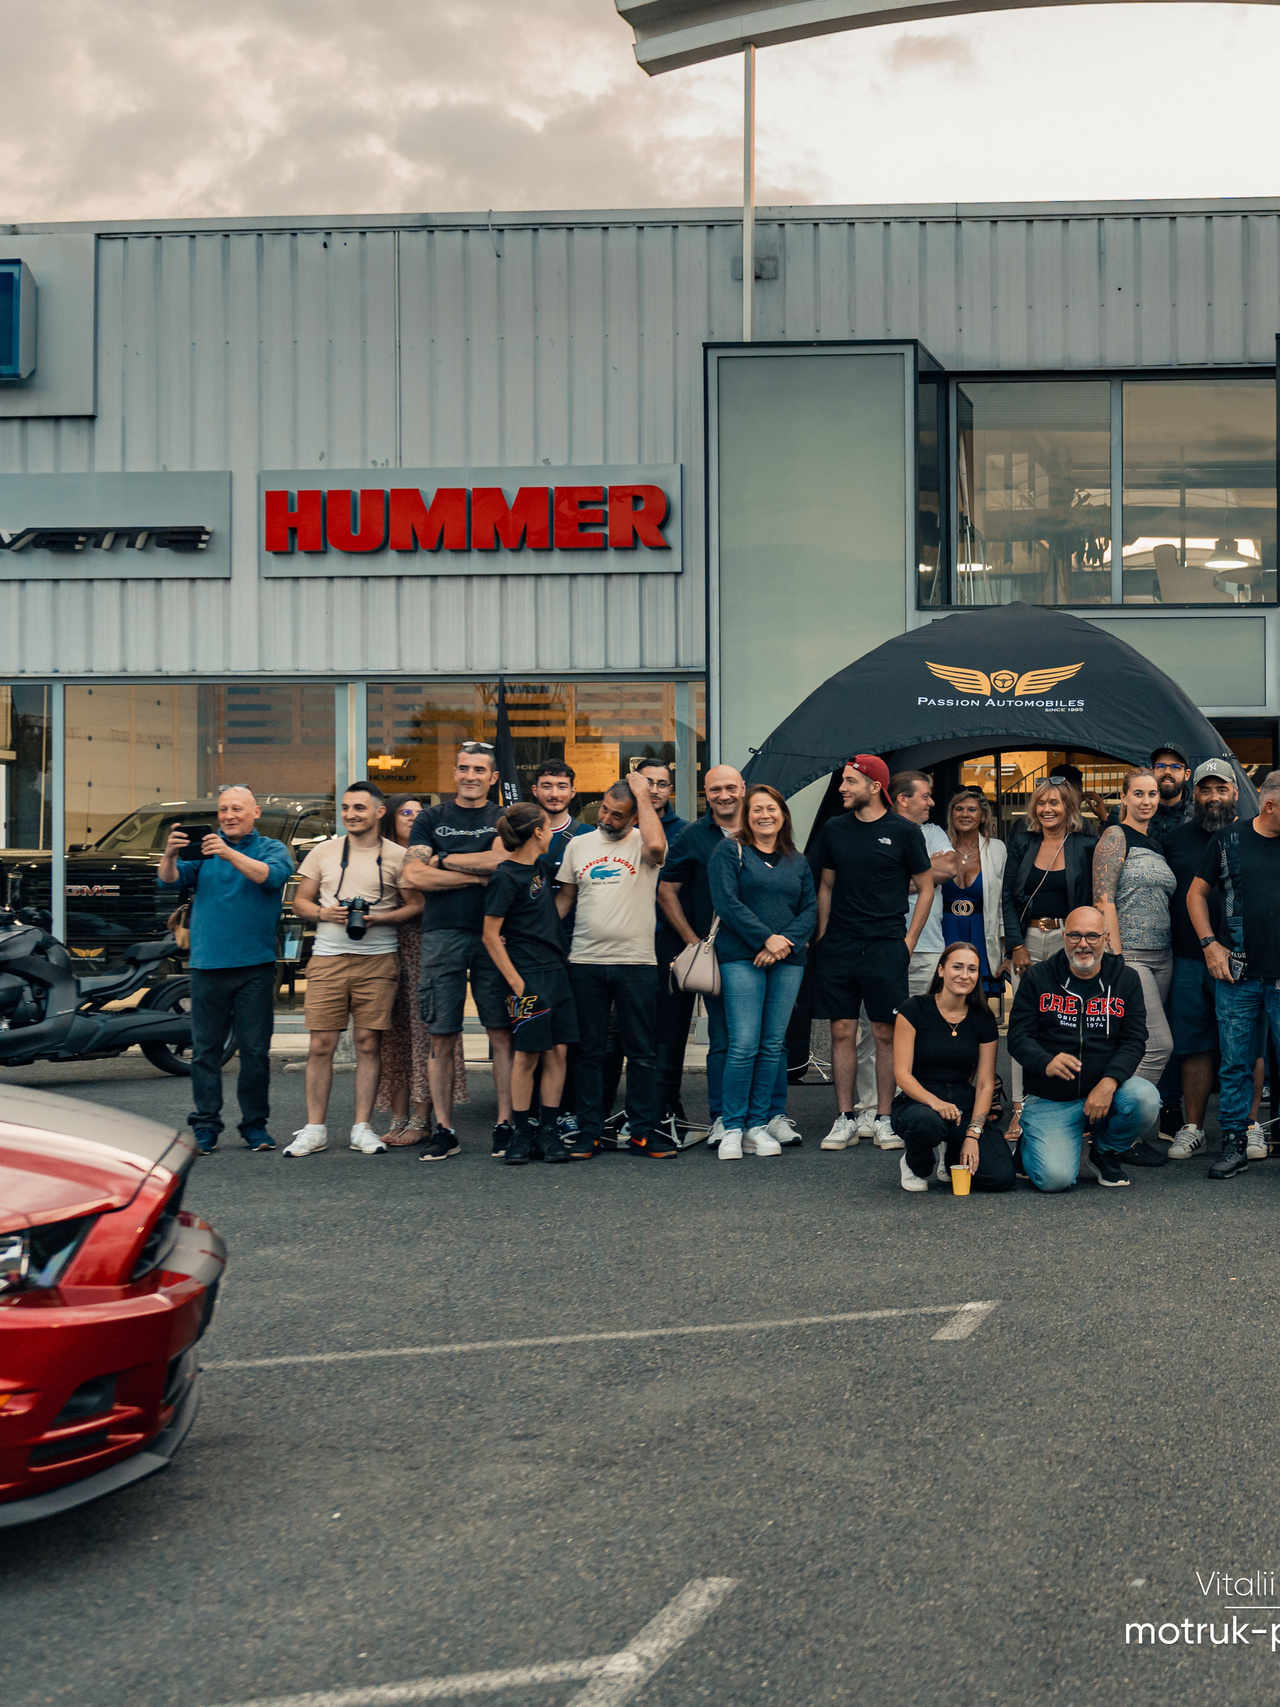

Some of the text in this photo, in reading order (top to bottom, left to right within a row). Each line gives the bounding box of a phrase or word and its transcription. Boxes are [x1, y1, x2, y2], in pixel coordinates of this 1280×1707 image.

[265, 484, 672, 553] HUMMER
[369, 774, 417, 782] HEVROLET
[65, 885, 120, 896] GMC
